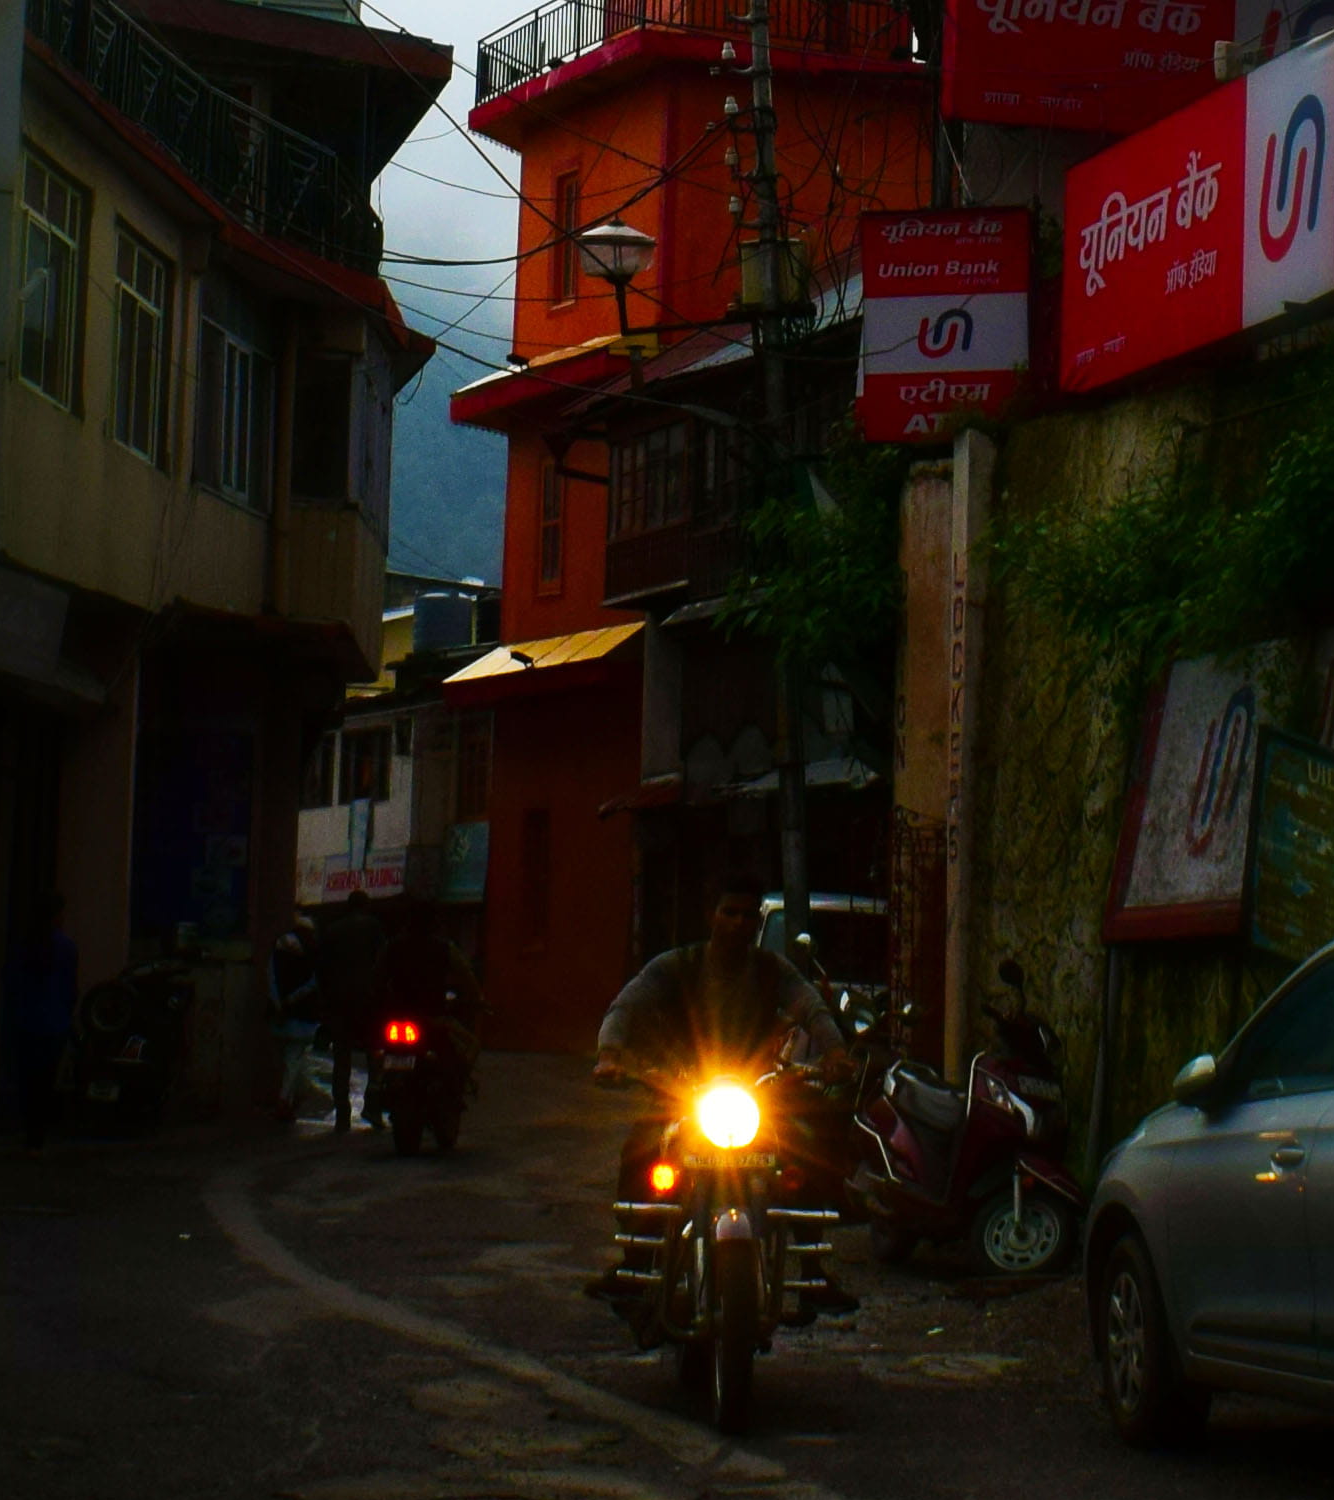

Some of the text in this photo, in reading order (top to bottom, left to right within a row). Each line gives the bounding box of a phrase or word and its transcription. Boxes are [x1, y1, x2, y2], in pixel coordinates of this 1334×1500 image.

[1079, 150, 1223, 298] यूनियन बैंक
[878, 258, 1000, 279] Union Bank
